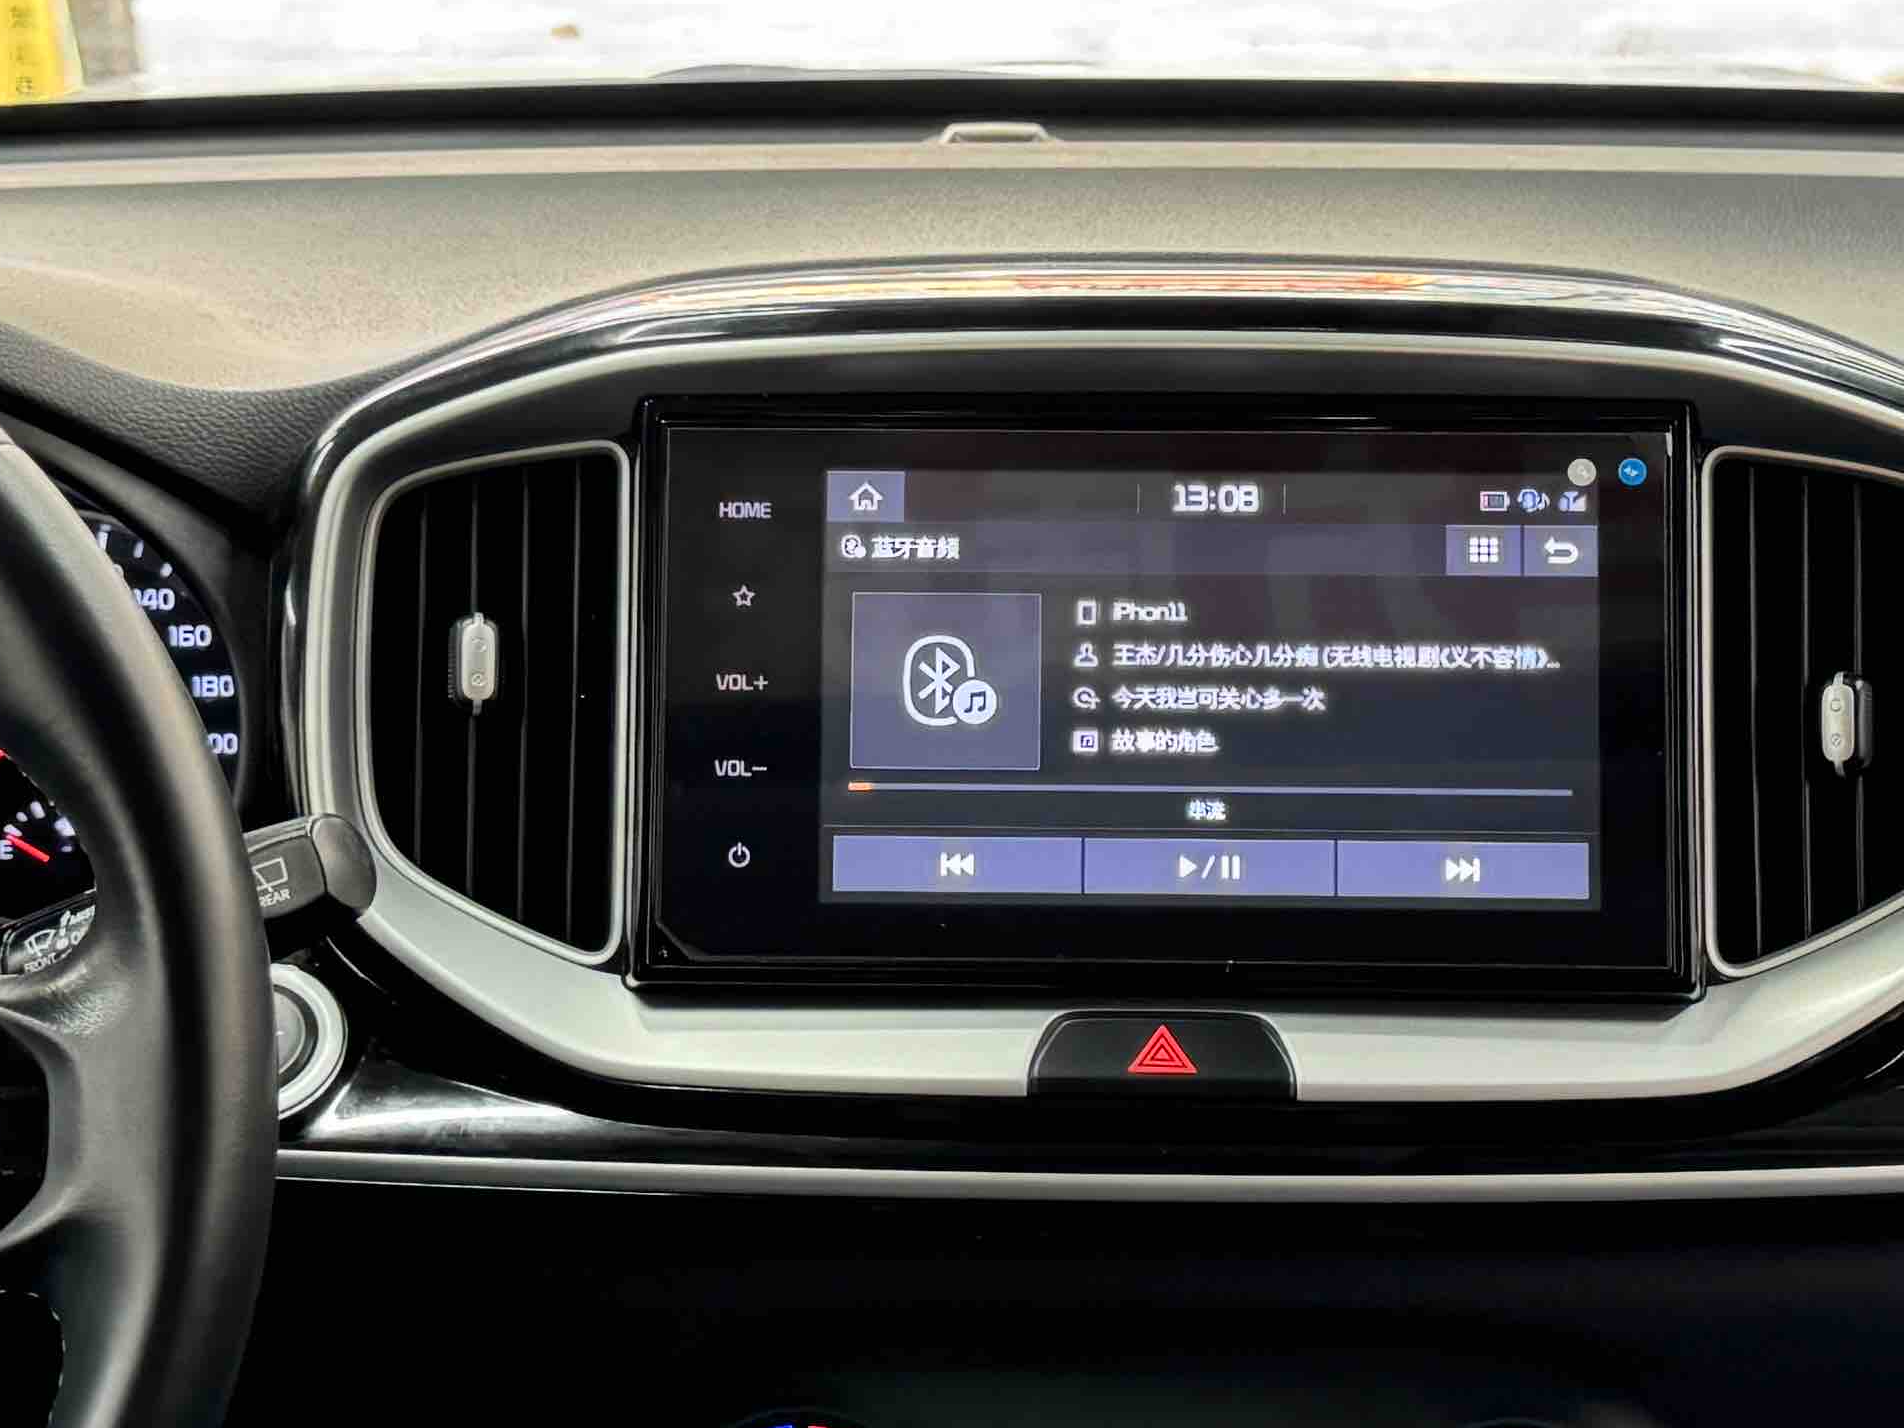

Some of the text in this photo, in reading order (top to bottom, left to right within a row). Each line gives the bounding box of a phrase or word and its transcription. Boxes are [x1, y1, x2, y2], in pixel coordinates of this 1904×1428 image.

[718, 500, 773, 519] HOME
[1172, 482, 1261, 514] 13:08
[870, 535, 962, 562] 蓝牙音频
[167, 624, 214, 649] 160
[190, 675, 236, 699] 180
[715, 672, 769, 692] VOL+
[1111, 684, 1328, 712] 今天我岂可关心多一次
[207, 732, 240, 757] 00
[1110, 728, 1222, 754] 故事的角色
[23, 951, 59, 973] FRONT
